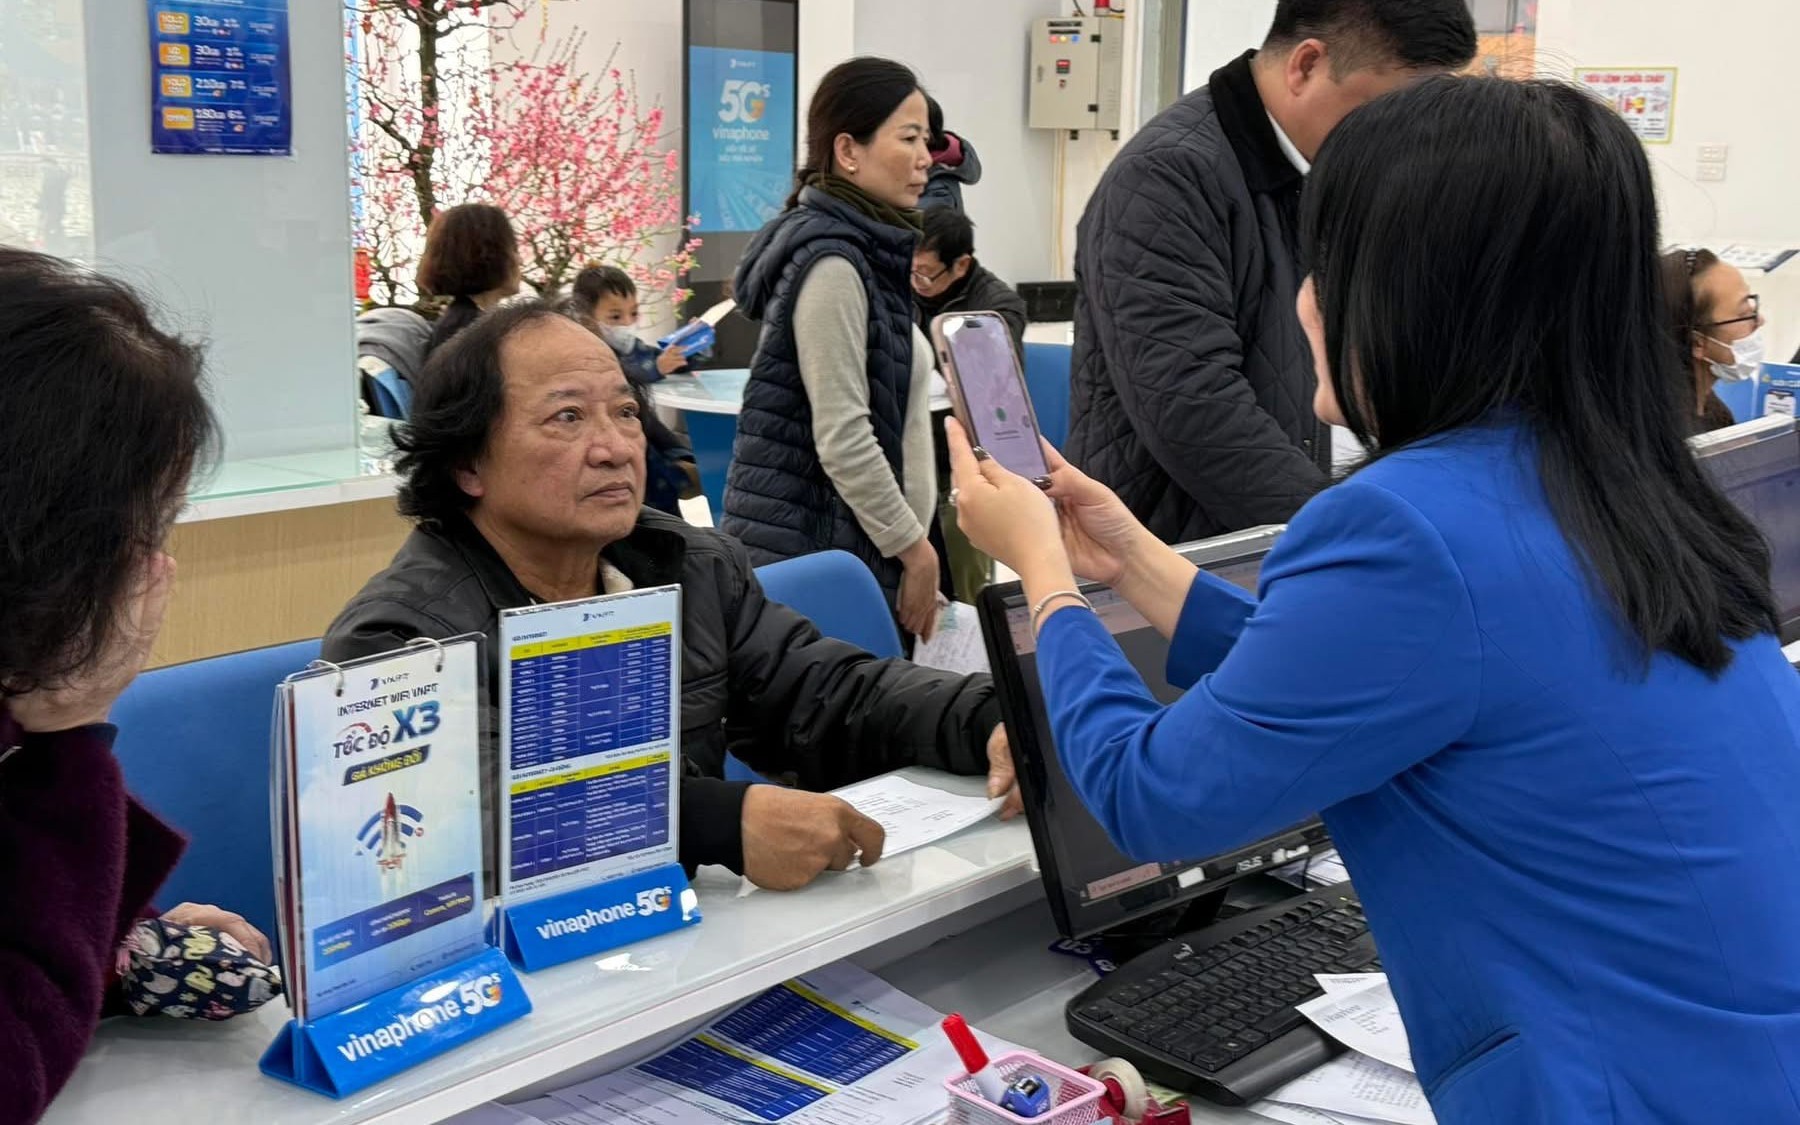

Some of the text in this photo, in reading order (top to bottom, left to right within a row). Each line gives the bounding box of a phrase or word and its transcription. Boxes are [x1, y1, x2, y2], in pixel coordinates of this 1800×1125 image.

[337, 695, 388, 717] INTERNET
[392, 699, 441, 743] X3
[536, 901, 637, 940] vinaphone
[337, 998, 462, 1062] vinaphone
